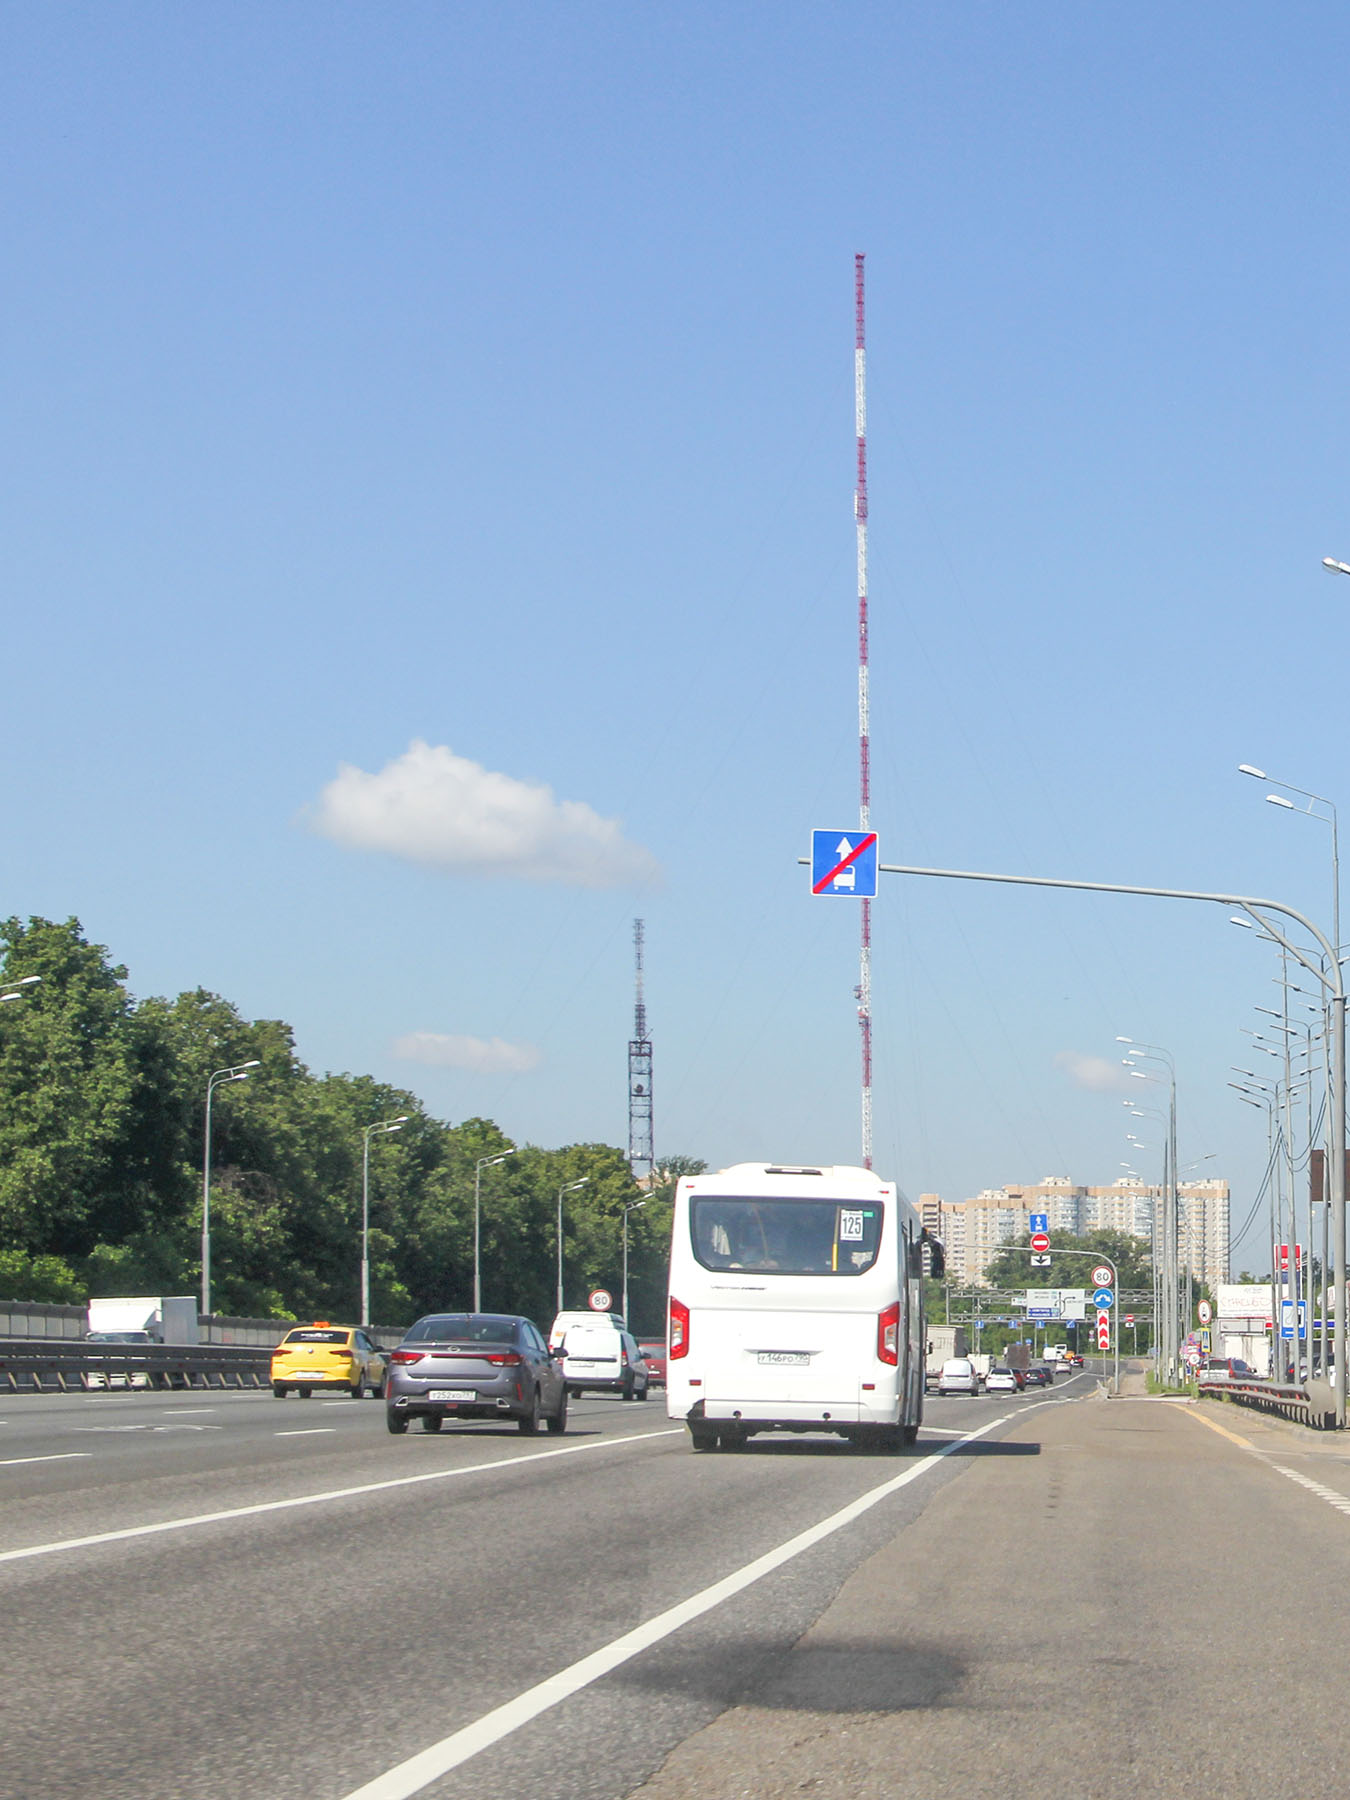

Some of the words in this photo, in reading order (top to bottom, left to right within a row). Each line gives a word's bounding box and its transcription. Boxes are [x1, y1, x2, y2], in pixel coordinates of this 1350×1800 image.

[843, 1216, 862, 1235] 125
[1096, 1272, 1110, 1282] 80
[594, 1296, 608, 1305] 80
